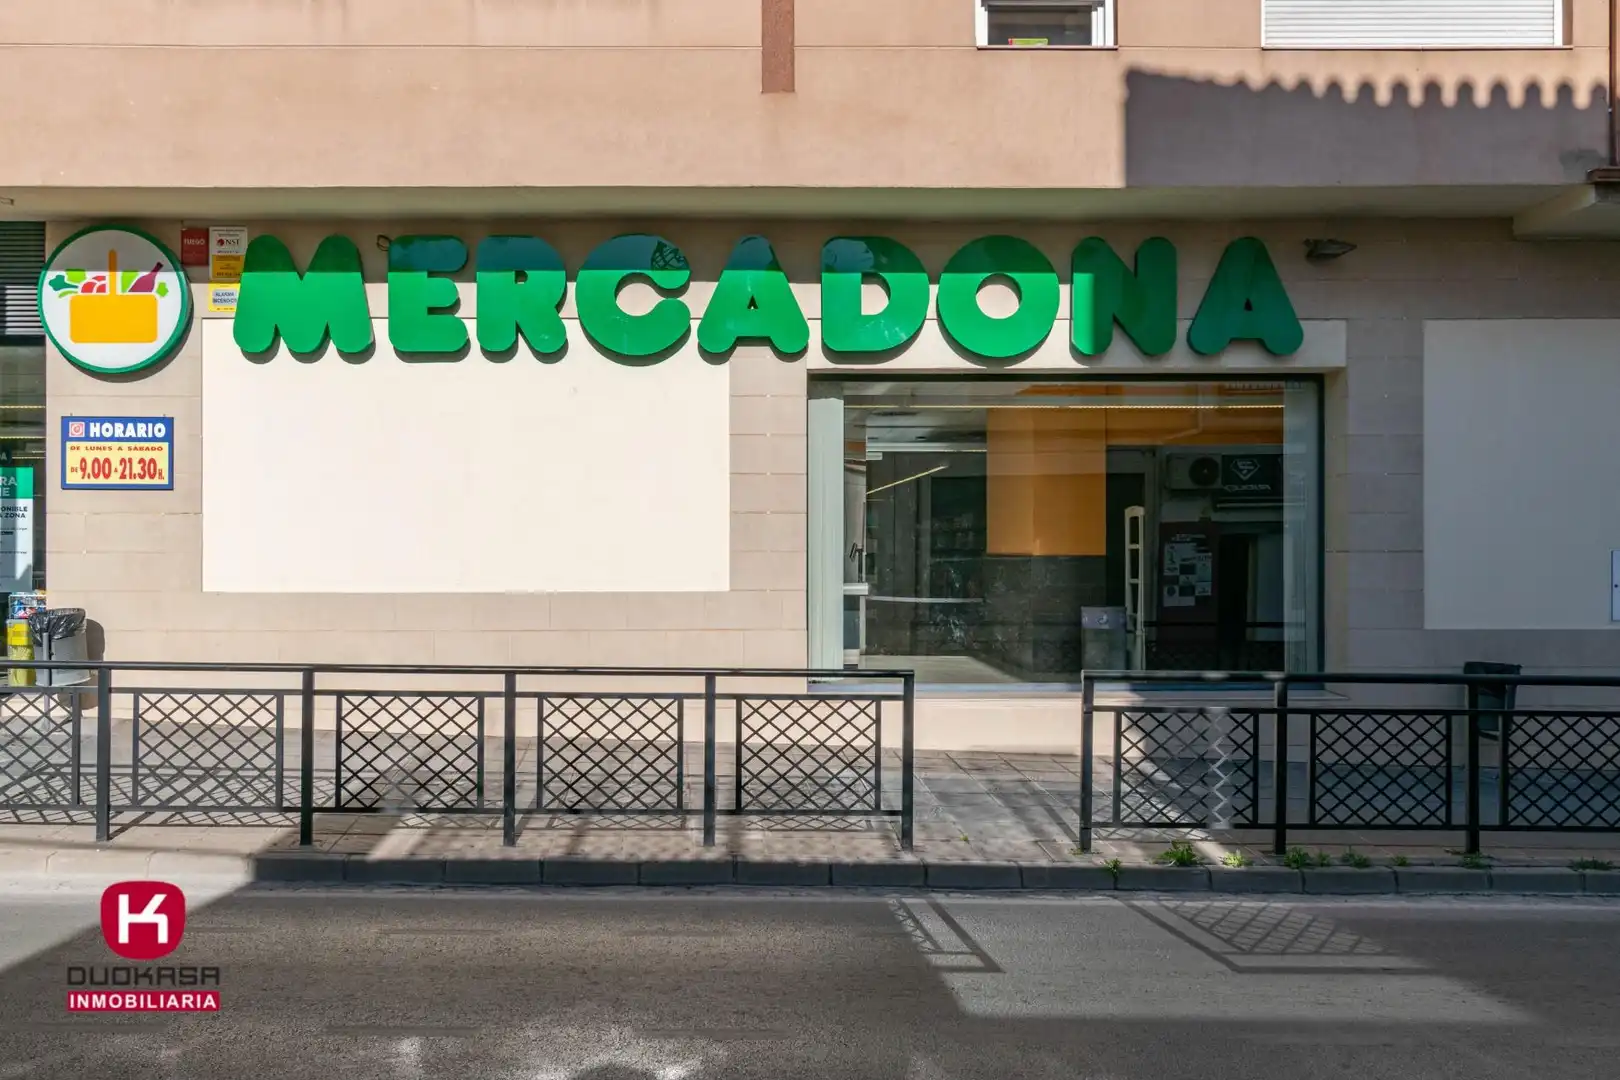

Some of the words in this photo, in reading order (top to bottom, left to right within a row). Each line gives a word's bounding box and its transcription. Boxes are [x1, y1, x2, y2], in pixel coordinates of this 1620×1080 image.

[232, 234, 1305, 359] MERCADONA
[89, 422, 166, 438] HORARIO
[79, 457, 112, 480] 9.00
[119, 457, 158, 480] 21.30
